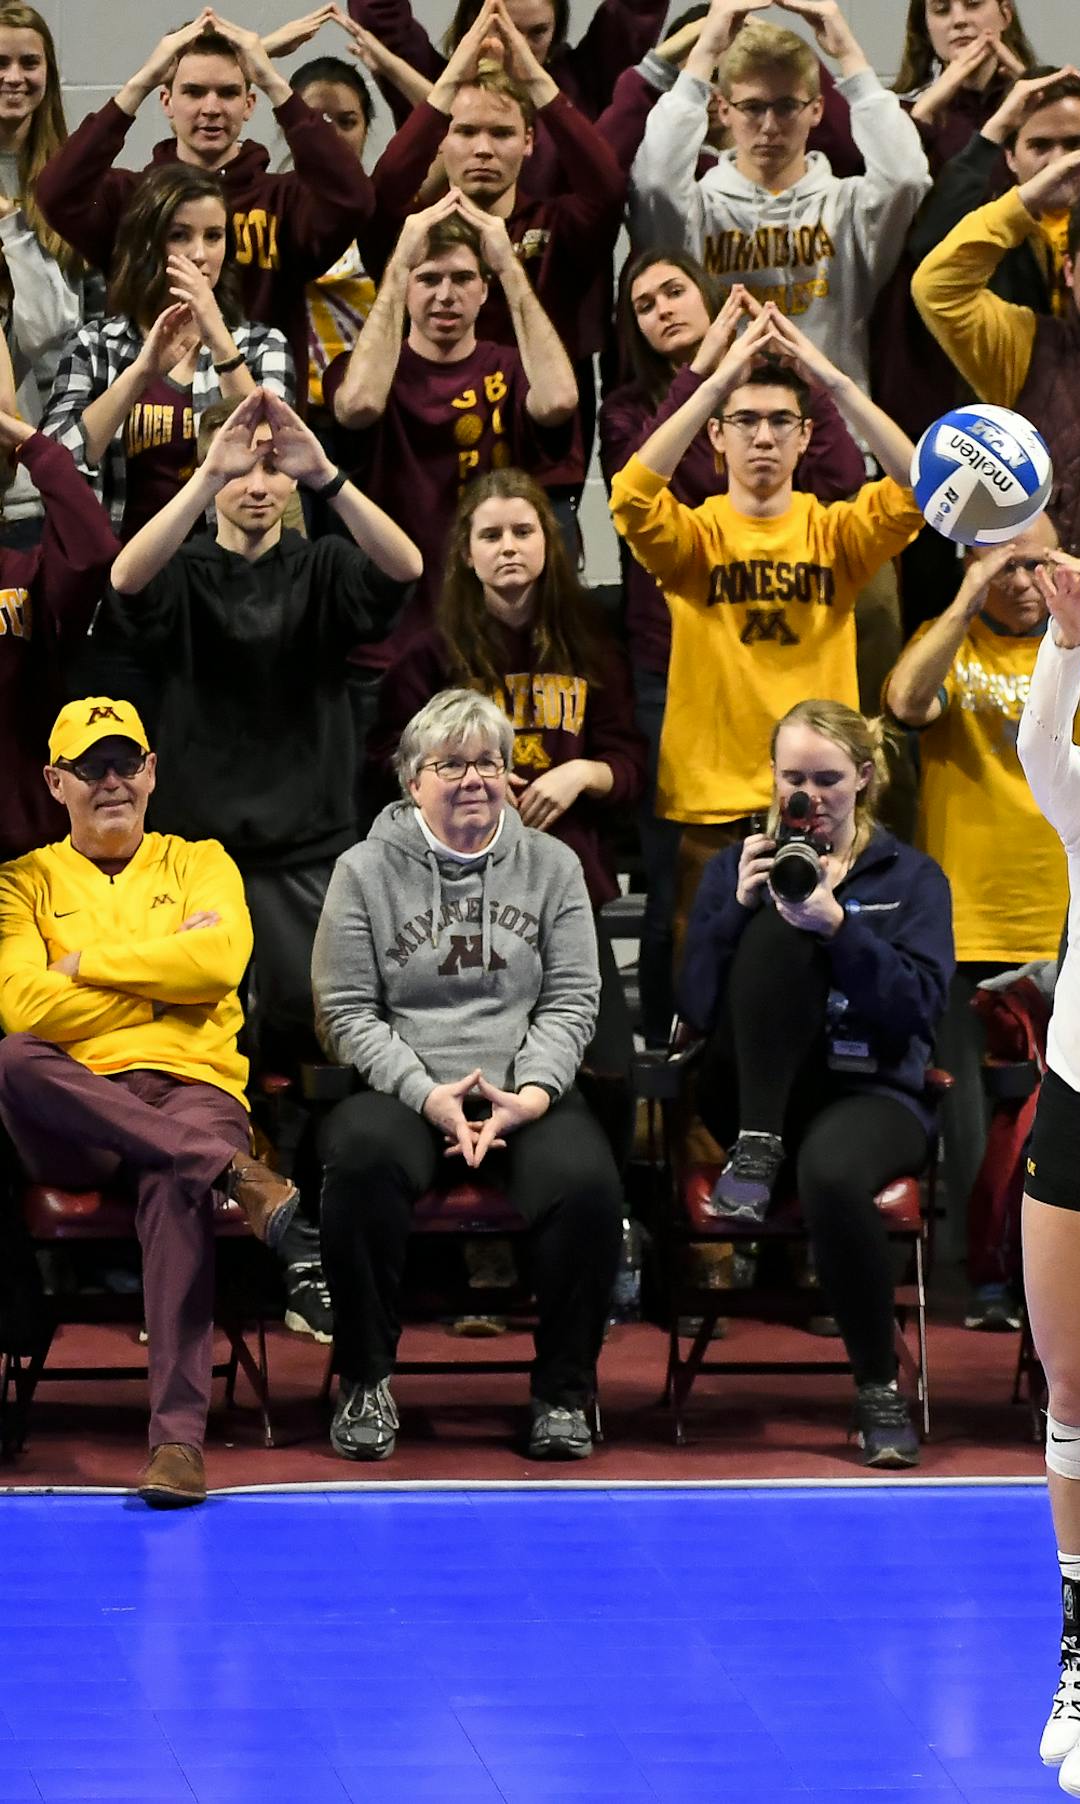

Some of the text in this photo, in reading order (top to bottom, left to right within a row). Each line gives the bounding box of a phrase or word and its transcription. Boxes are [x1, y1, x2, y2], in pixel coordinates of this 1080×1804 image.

[949, 434, 1014, 493] molten
[86, 706, 124, 726] M
[437, 934, 508, 976] M
